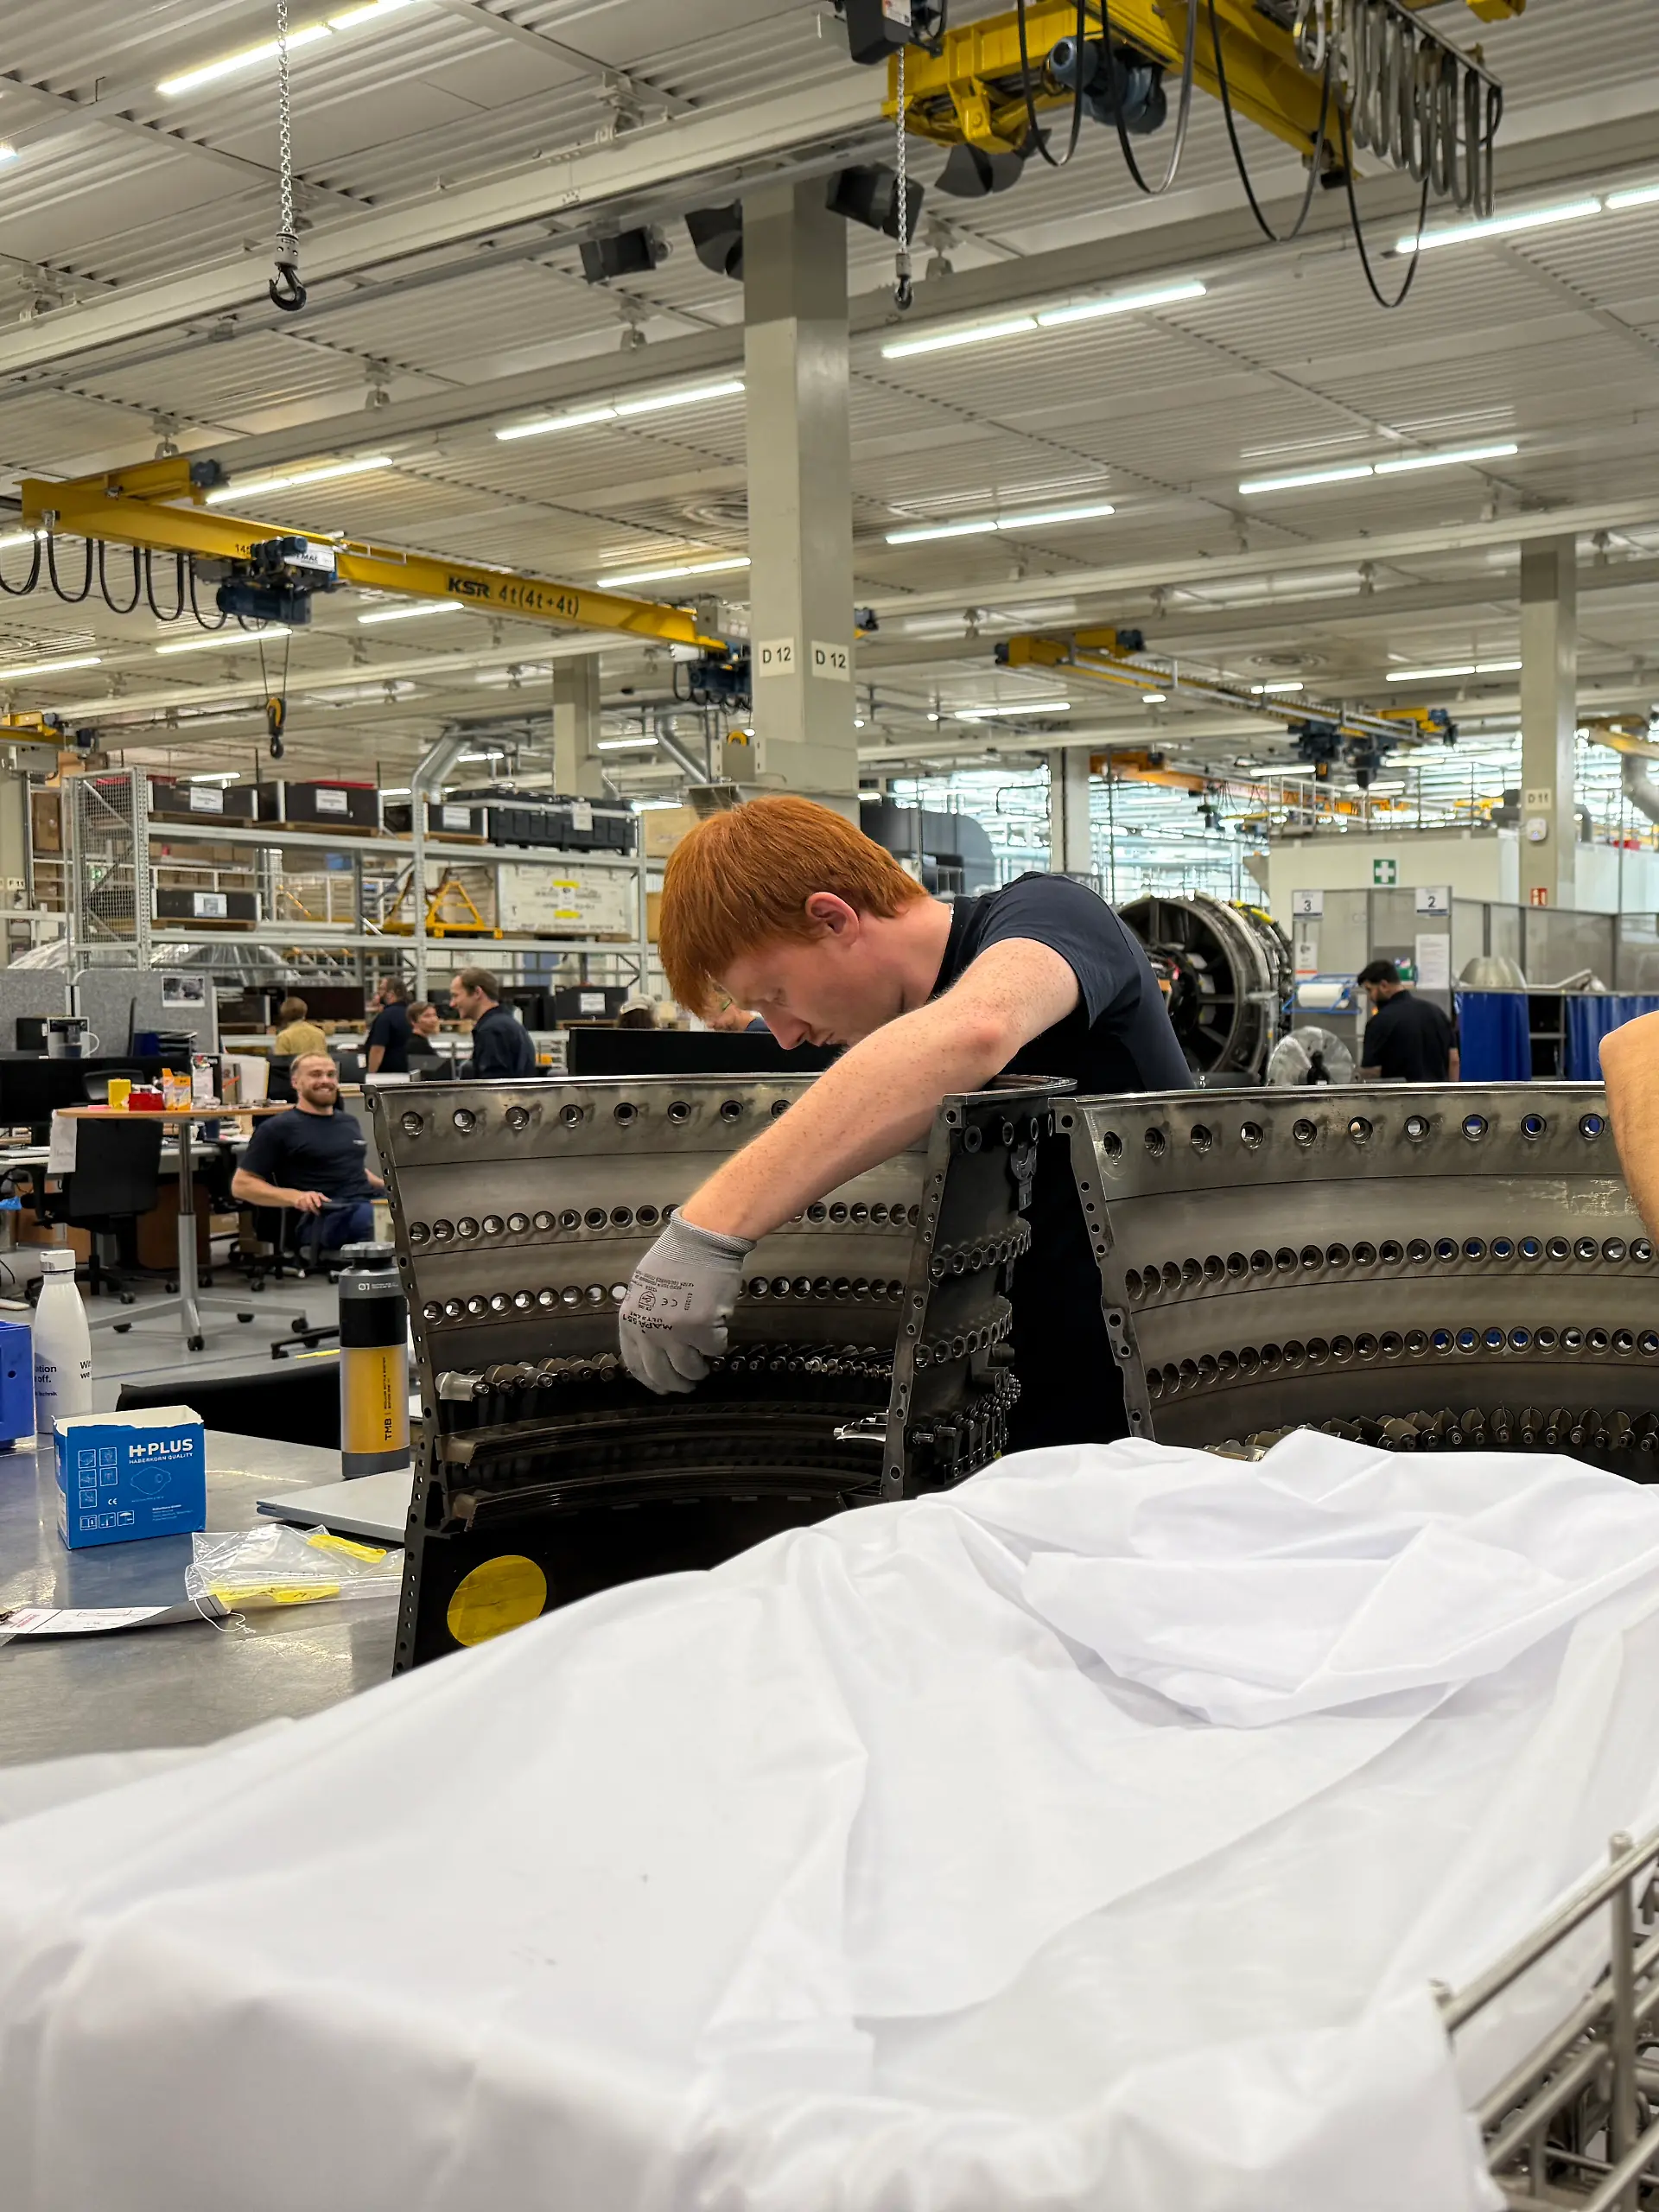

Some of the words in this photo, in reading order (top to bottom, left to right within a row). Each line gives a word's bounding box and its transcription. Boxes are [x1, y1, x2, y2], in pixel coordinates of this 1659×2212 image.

[448, 576, 491, 599] KSR
[762, 649, 772, 664] D
[777, 645, 791, 663] 12
[816, 649, 825, 665] D
[830, 652, 847, 669] 12
[1528, 793, 1536, 804] D
[1304, 899, 1312, 912] 3
[1427, 895, 1436, 908] 2
[384, 1418, 392, 1441] TMB
[129, 1456, 167, 1465] HABERKORN
